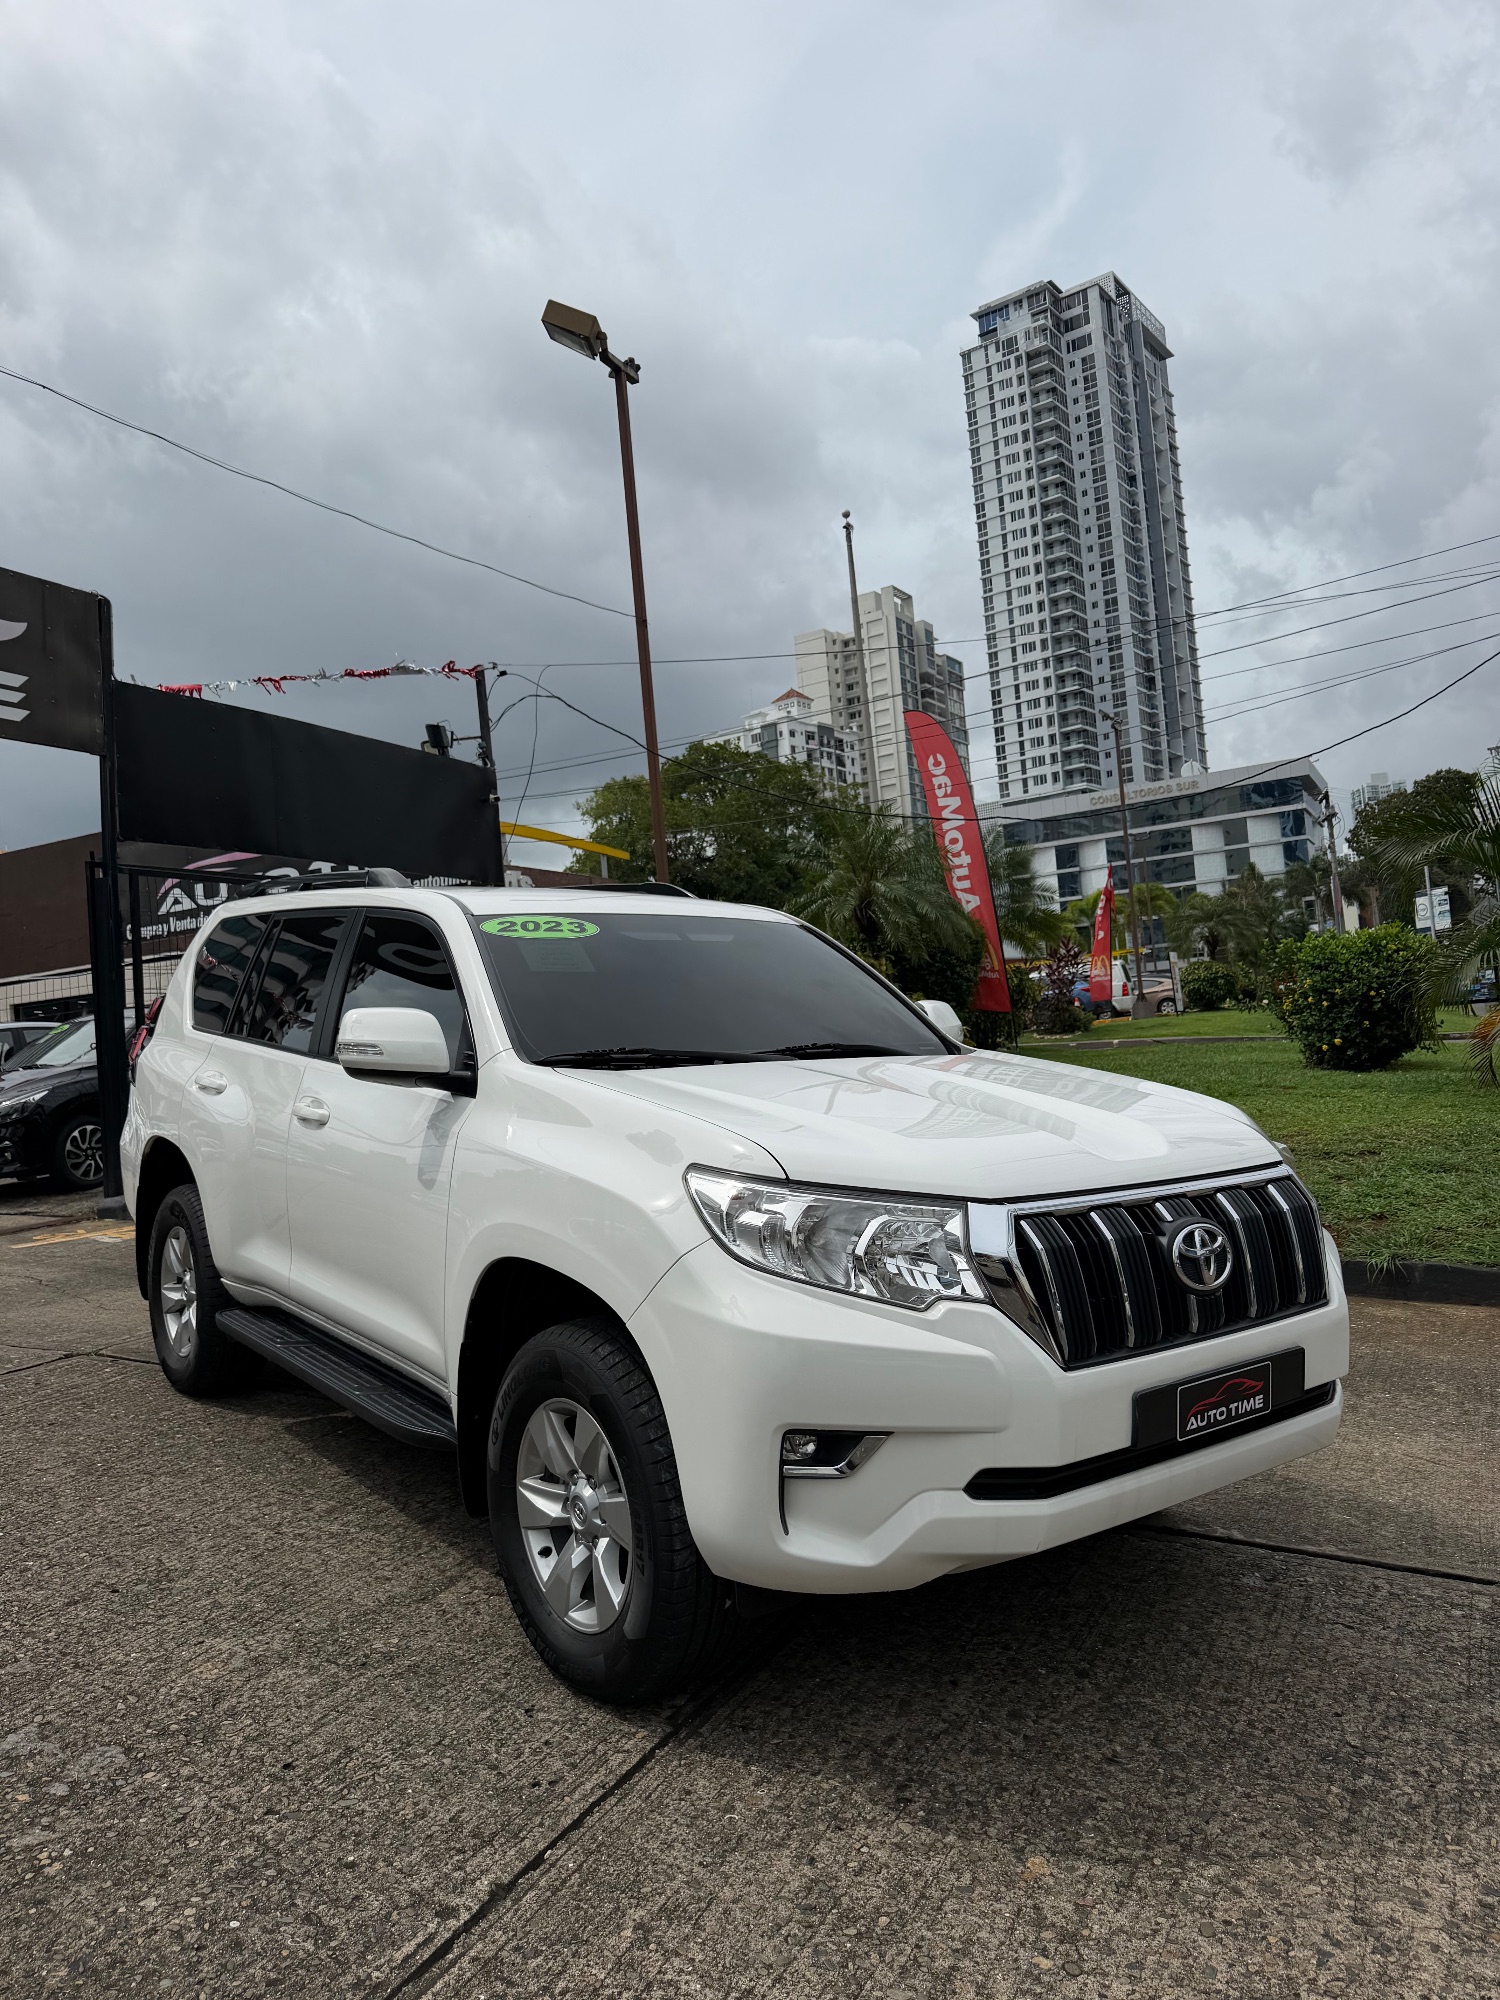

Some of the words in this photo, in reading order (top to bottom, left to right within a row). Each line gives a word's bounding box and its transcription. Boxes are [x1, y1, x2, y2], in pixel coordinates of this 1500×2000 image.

[1176, 780, 1199, 792] SUR
[169, 915, 196, 933] Venta
[496, 920, 588, 934] 2023
[1186, 1406, 1227, 1432] AUTO
[1229, 1394, 1264, 1417] TIME
